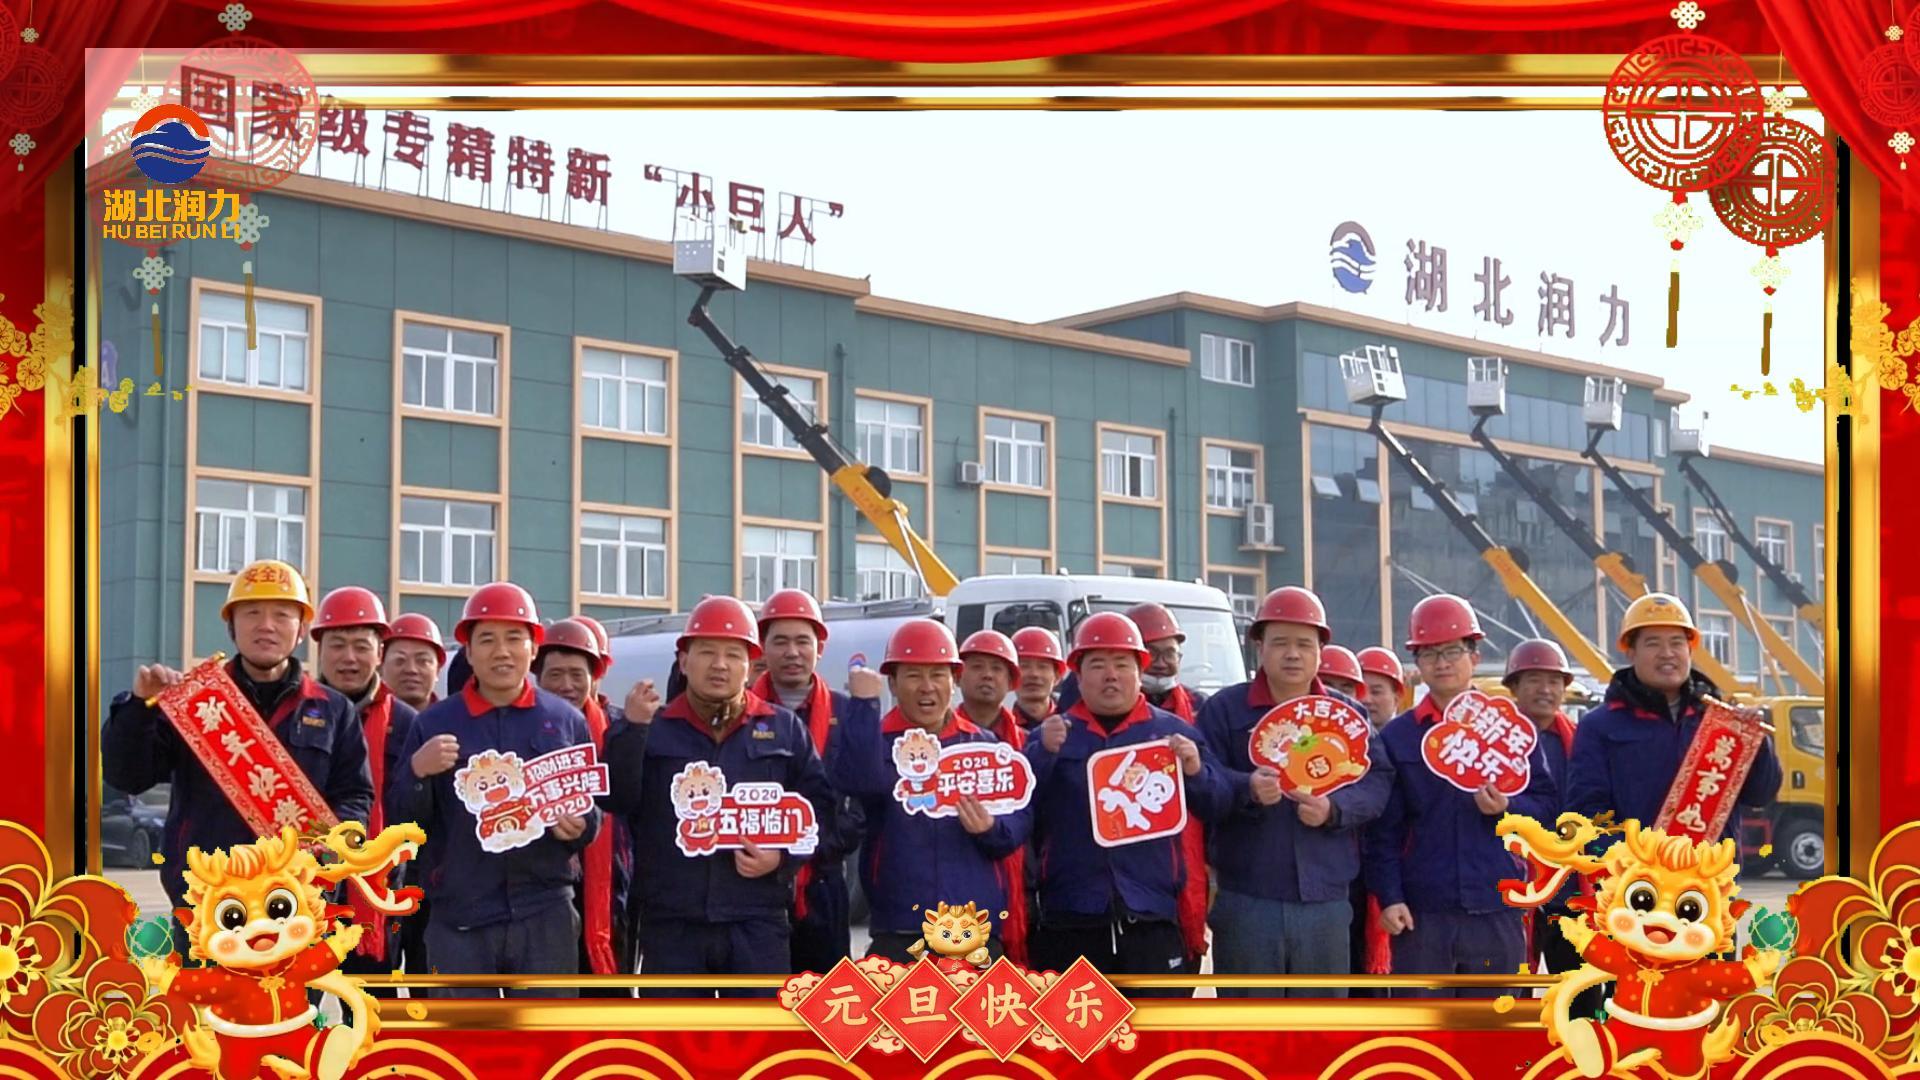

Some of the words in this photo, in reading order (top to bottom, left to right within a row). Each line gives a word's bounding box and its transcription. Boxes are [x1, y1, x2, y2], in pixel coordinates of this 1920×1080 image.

[1404, 238, 1630, 347] 湖北润力
[1293, 700, 1366, 740] 大吉大利
[1472, 706, 1533, 756] 新年
[953, 756, 989, 770] 2024
[1308, 756, 1330, 778] 福
[1439, 729, 1516, 783] 快乐
[528, 770, 601, 806] 万事兴隆
[738, 789, 778, 801] 2024
[937, 766, 1015, 797] 平安喜乐
[1675, 734, 1736, 839] 萬事如
[543, 797, 587, 821] 2024
[719, 808, 804, 835] 五福临门
